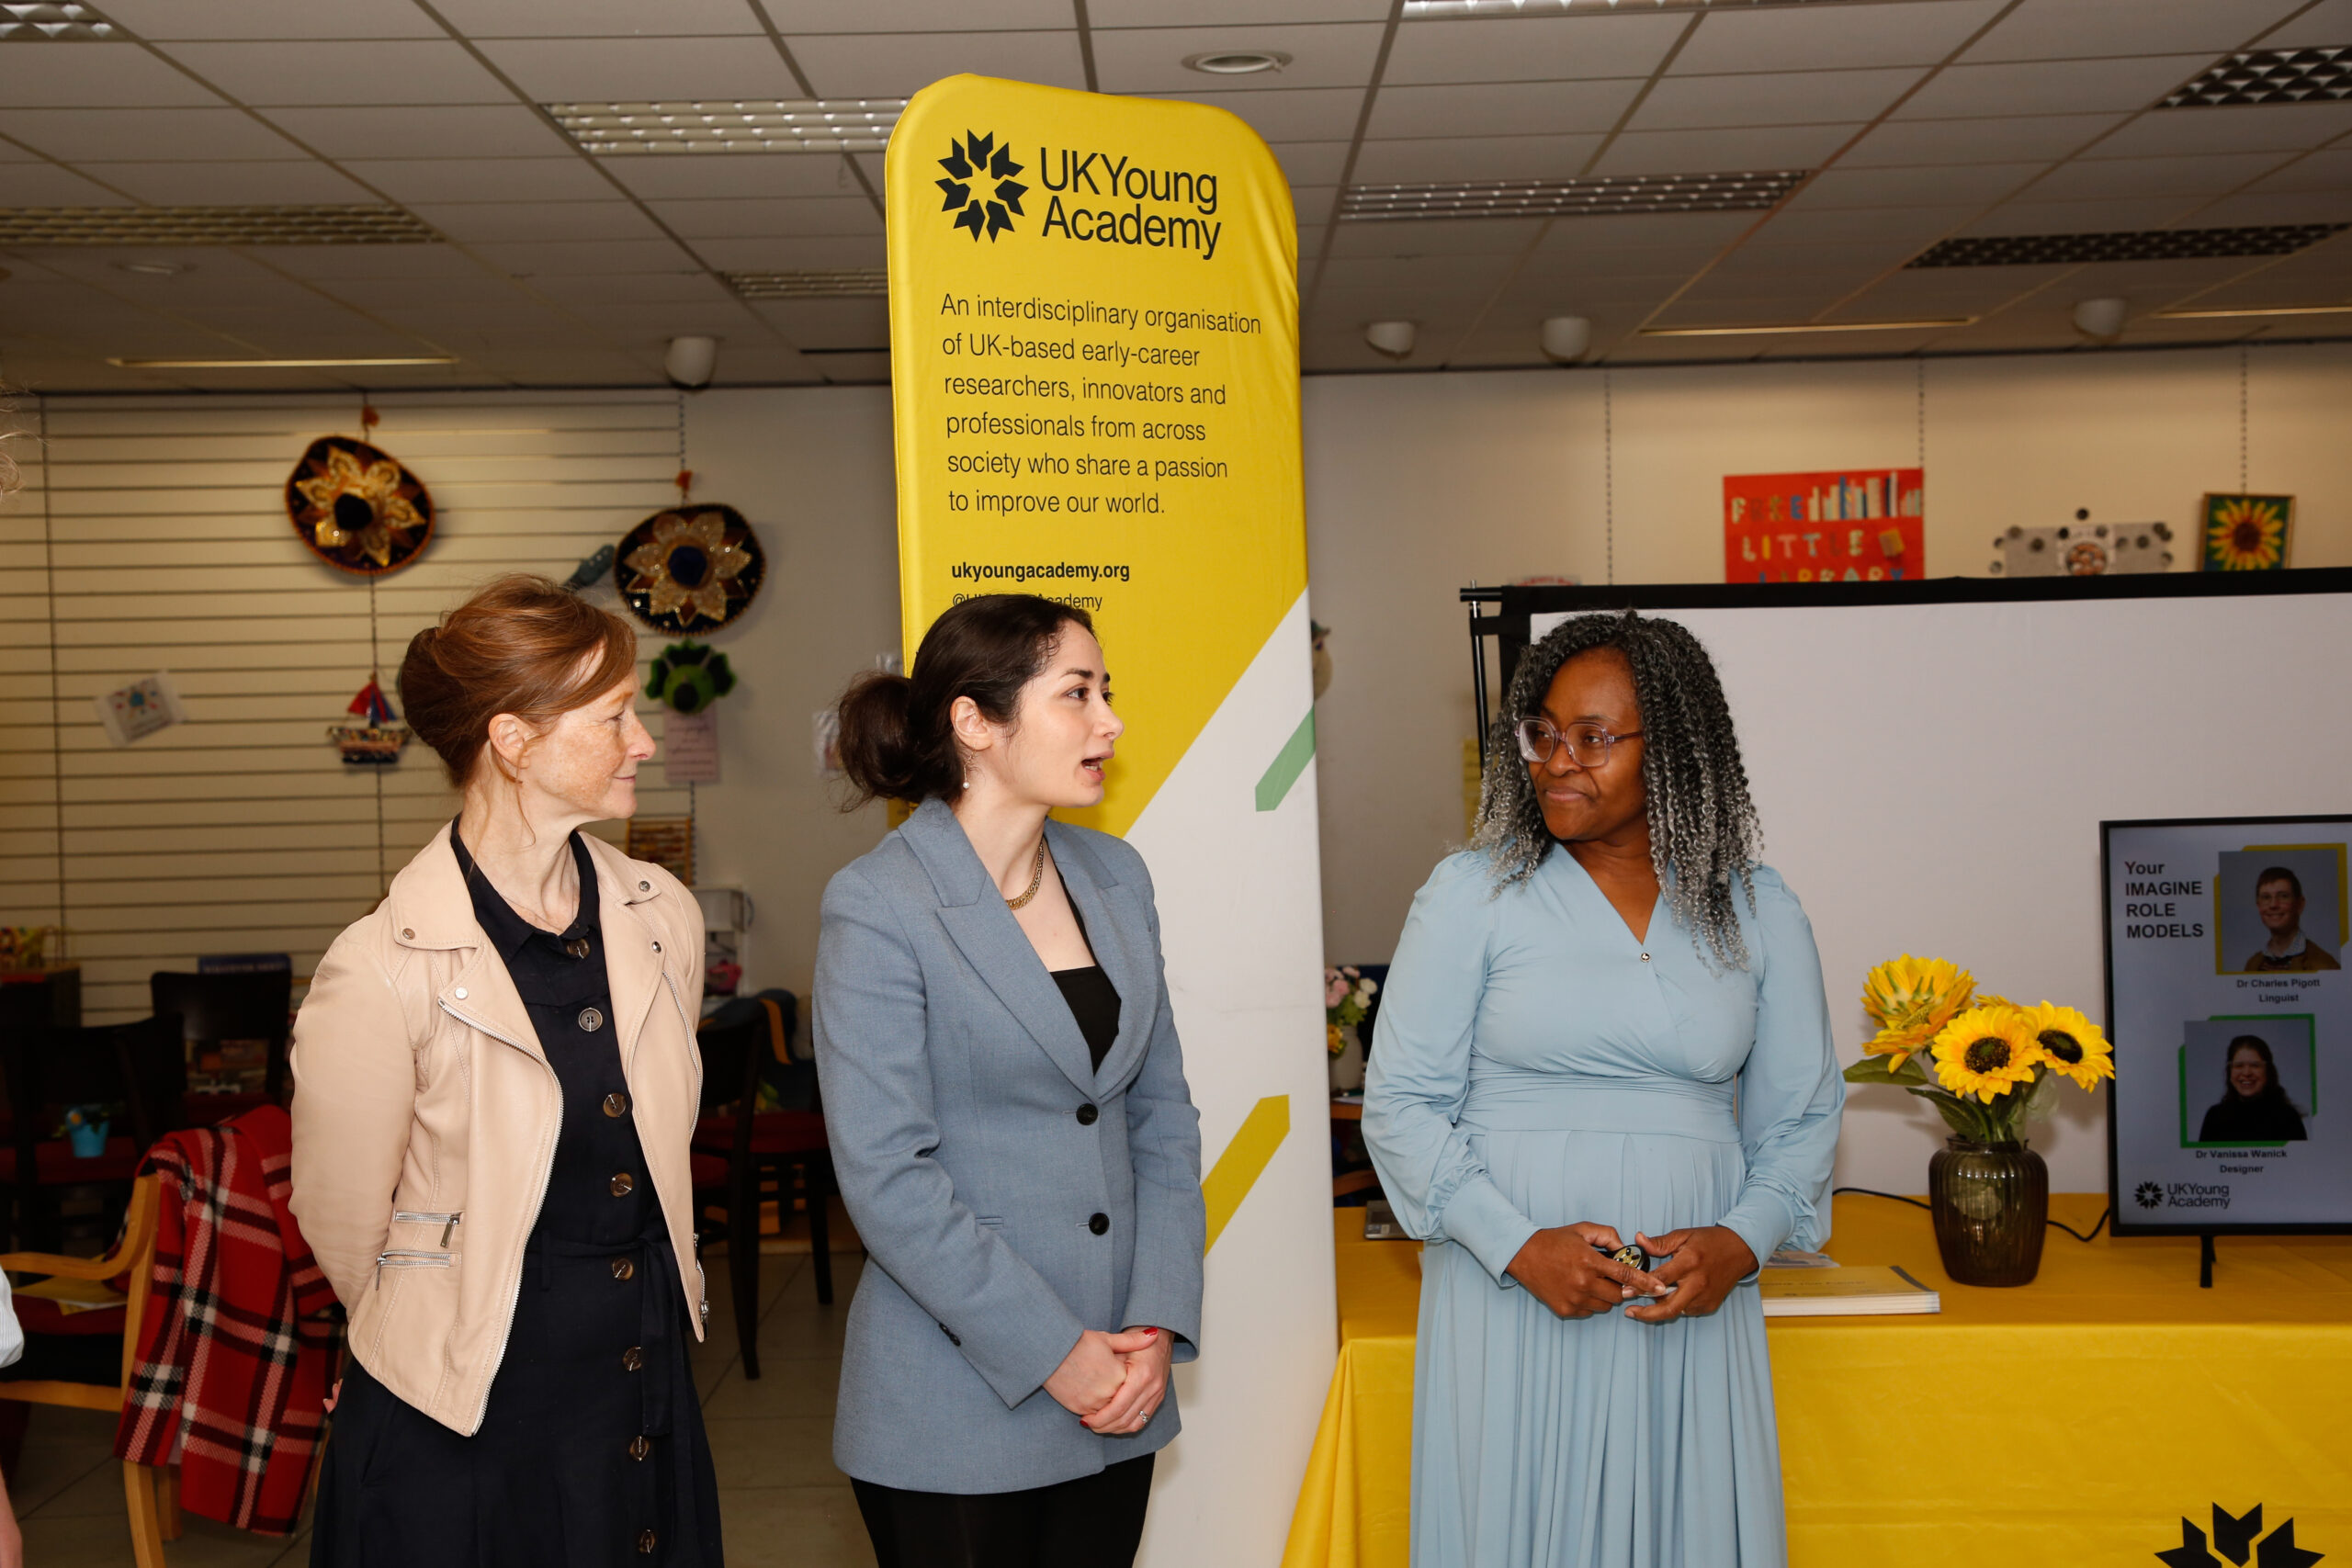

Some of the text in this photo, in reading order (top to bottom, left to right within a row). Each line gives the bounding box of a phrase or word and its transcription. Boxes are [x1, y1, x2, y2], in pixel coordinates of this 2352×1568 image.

[1042, 197, 1221, 260] Academy
[941, 294, 1261, 333] An interdisciplinary organisation
[943, 333, 1200, 367] of UK-based early-career
[945, 375, 1225, 404] researchers, innovators and
[947, 412, 1205, 440] professionals from across
[948, 451, 1227, 481] society who share a passion
[949, 490, 1164, 516] to improve our world.
[1732, 495, 1804, 523] FREE
[1743, 530, 1863, 561] LITTLE
[952, 562, 1129, 582] ukyoungacademy.org
[2125, 862, 2165, 874] Your
[2126, 882, 2202, 896] IMAGINE
[2127, 903, 2176, 917] ROLE
[2128, 923, 2203, 938] MODELS
[2237, 978, 2320, 989] Dr Charles Pigott
[2259, 994, 2299, 1005] Linguist
[2196, 1149, 2287, 1159] Dr Vanissa Wanick
[2220, 1164, 2263, 1176] Designer
[2167, 1195, 2230, 1209] Academy
